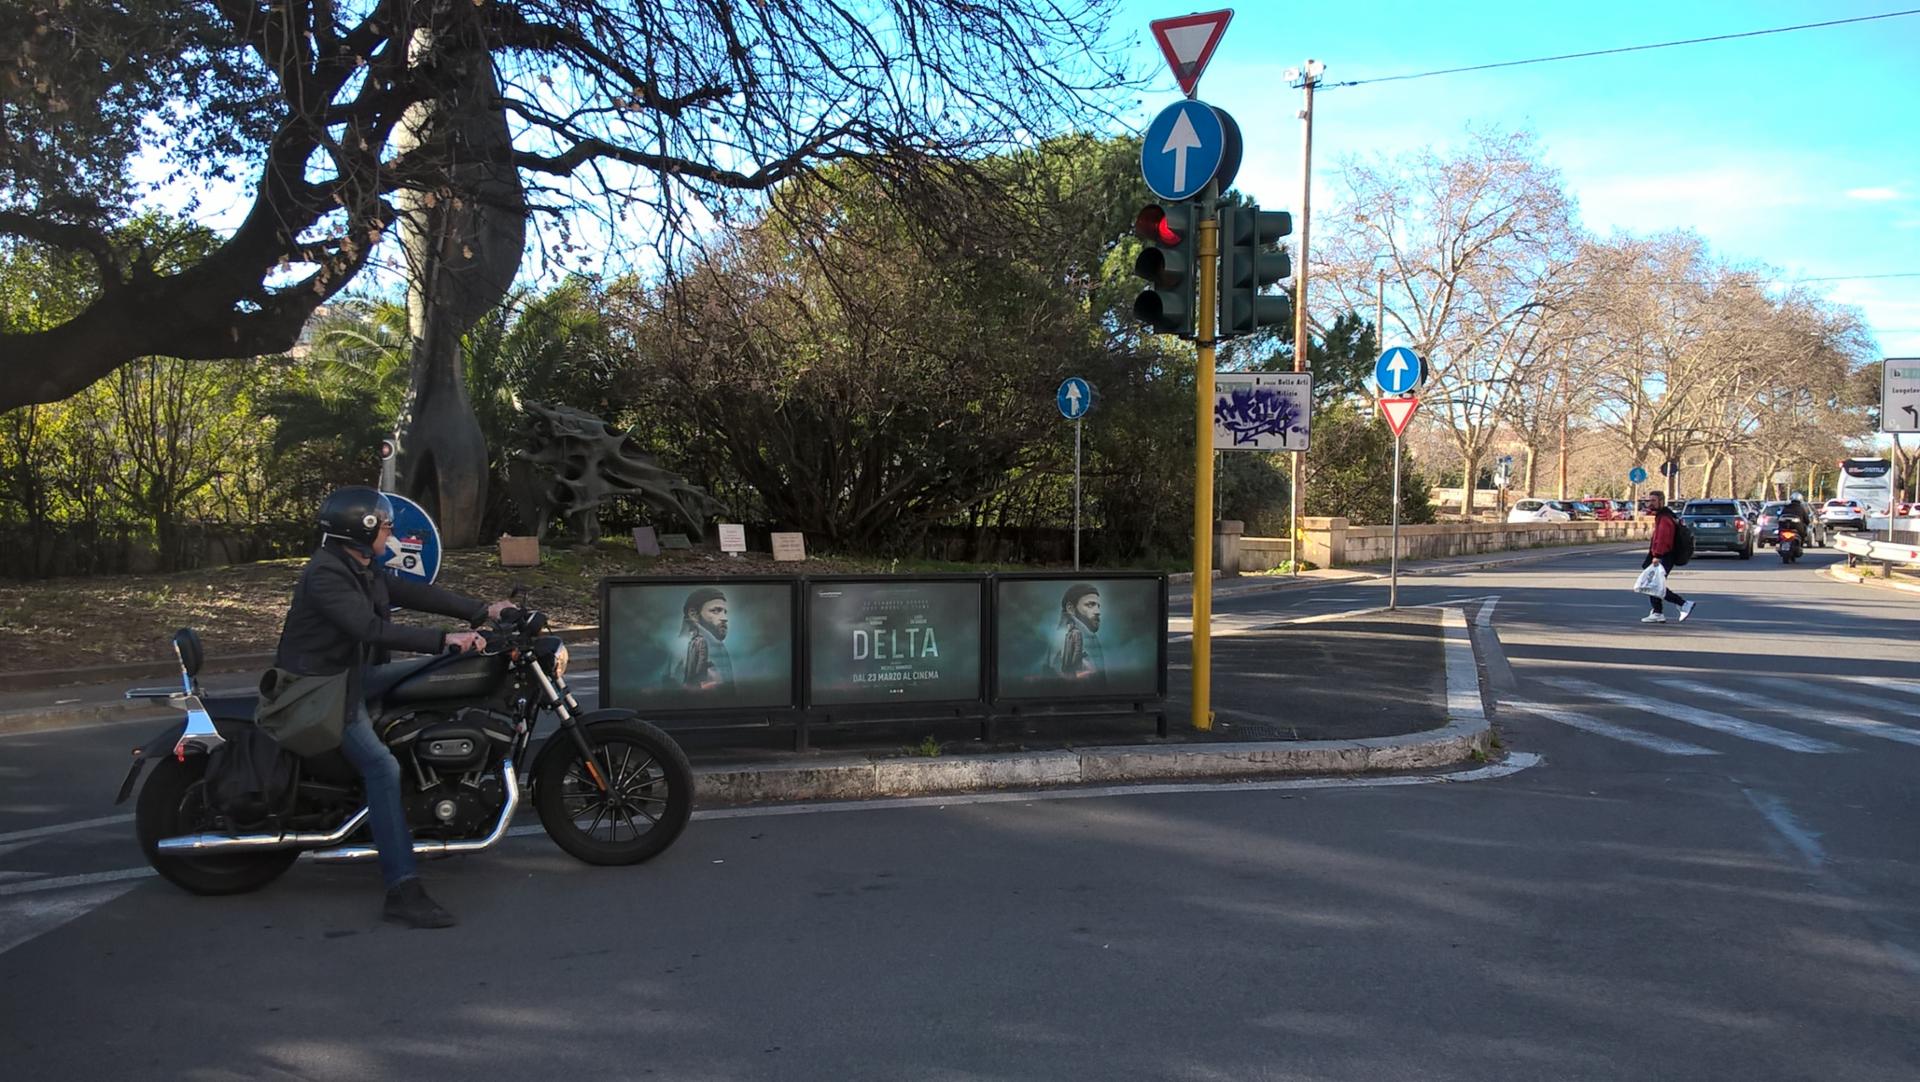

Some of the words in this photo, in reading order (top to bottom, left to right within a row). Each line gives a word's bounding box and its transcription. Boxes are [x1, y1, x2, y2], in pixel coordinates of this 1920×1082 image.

[853, 627, 939, 660] DELTA
[852, 673, 866, 682] DAL
[867, 673, 877, 682] 23
[877, 672, 902, 682] MARZO
[902, 671, 912, 681] AL
[912, 670, 939, 680] CINEMA
